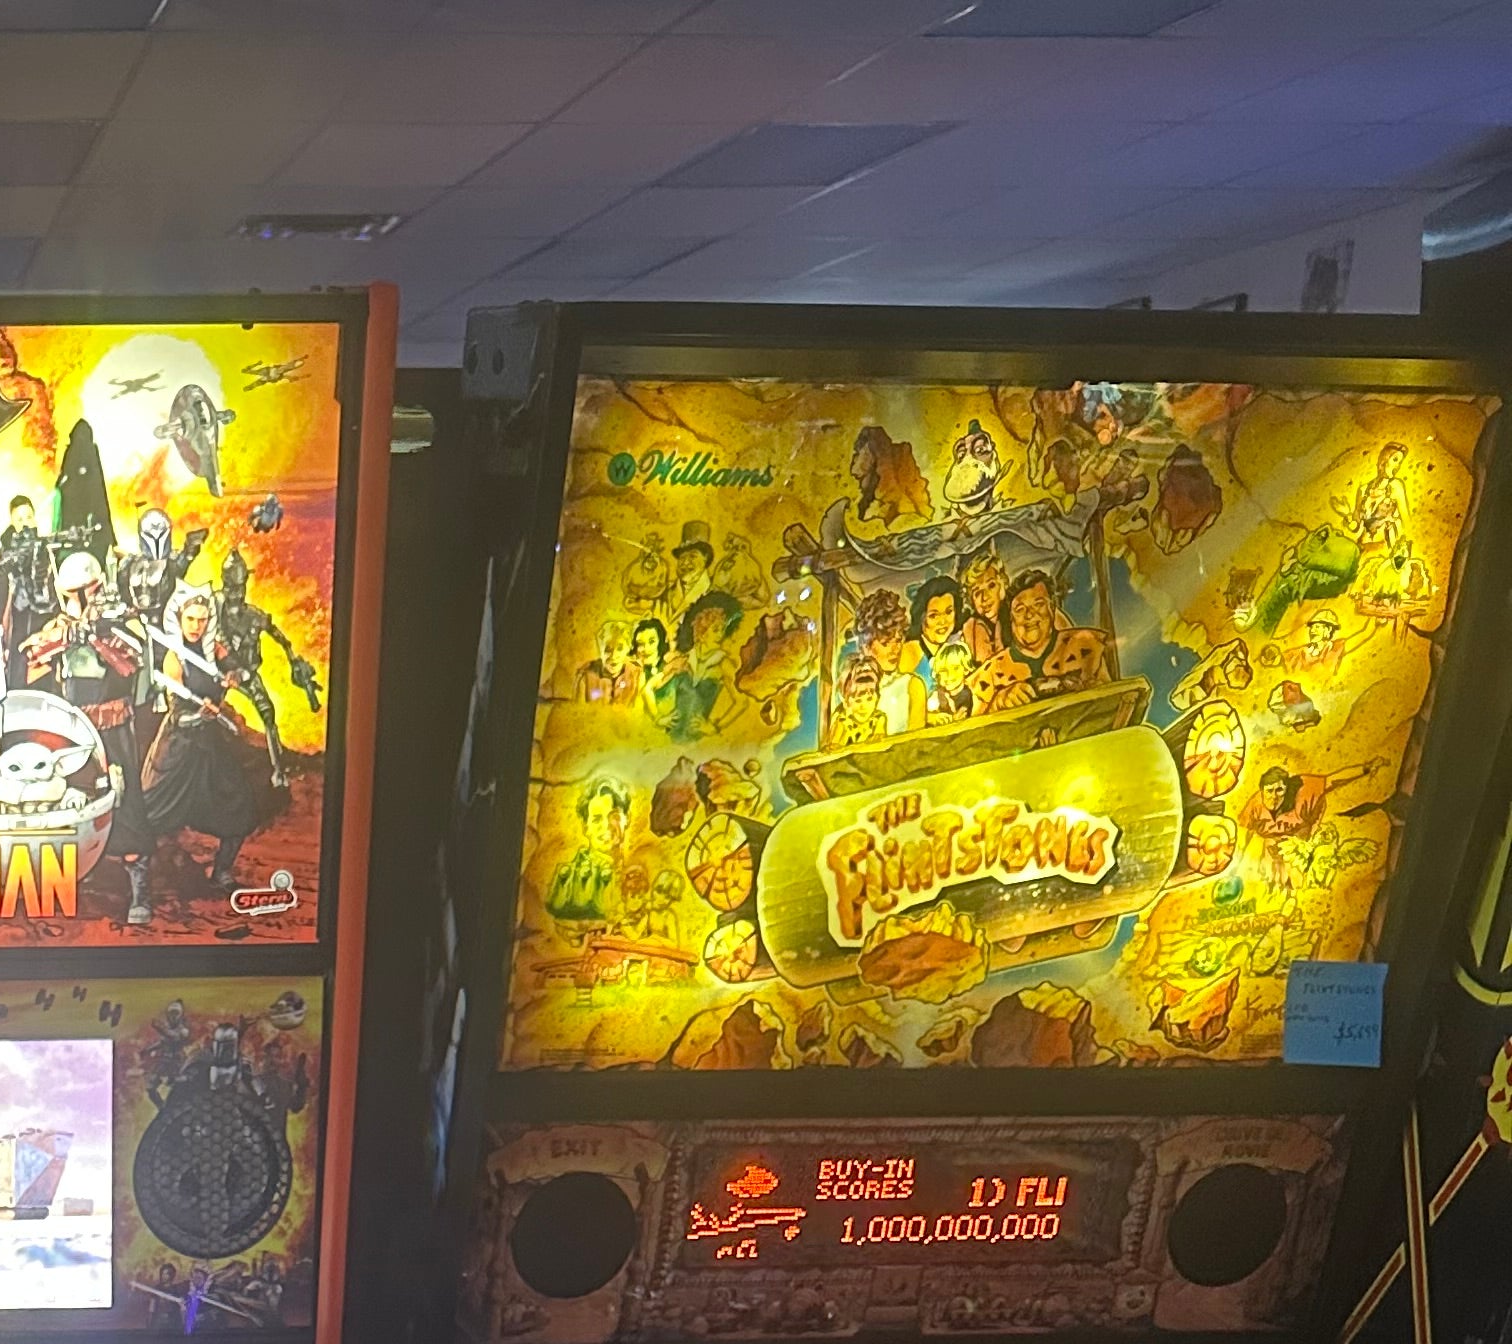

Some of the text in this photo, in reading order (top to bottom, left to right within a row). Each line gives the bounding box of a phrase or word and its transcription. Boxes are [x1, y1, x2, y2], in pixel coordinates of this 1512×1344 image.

[639, 450, 776, 487] Williams
[867, 792, 922, 835] THE
[826, 804, 1109, 940] FLINTSTONES
[238, 894, 289, 907] Stern
[818, 1159, 915, 1180] BUY-IN
[815, 1180, 914, 1200] SCORES
[968, 1176, 1069, 1207] 1) FLI
[840, 1214, 1060, 1246] 1,000,000,000
